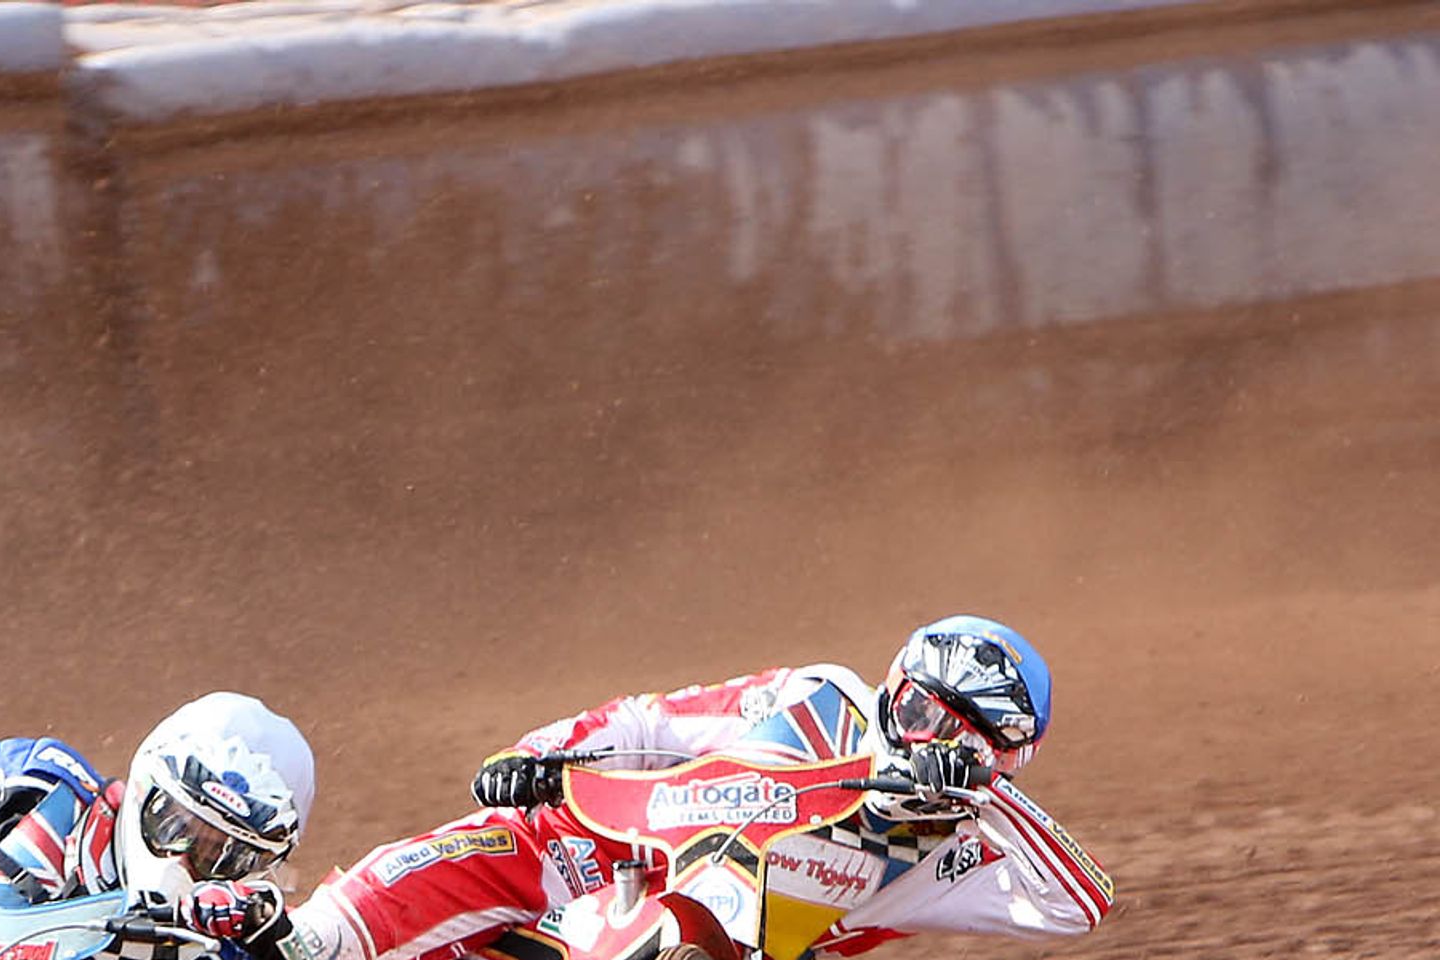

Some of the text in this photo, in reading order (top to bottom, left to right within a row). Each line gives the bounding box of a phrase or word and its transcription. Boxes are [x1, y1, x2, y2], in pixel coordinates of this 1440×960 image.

[651, 781, 792, 813] Autogate
[385, 833, 509, 876] Allied Vehicles
[806, 856, 868, 893] Tigers
[1052, 822, 1112, 891] Vehicles
